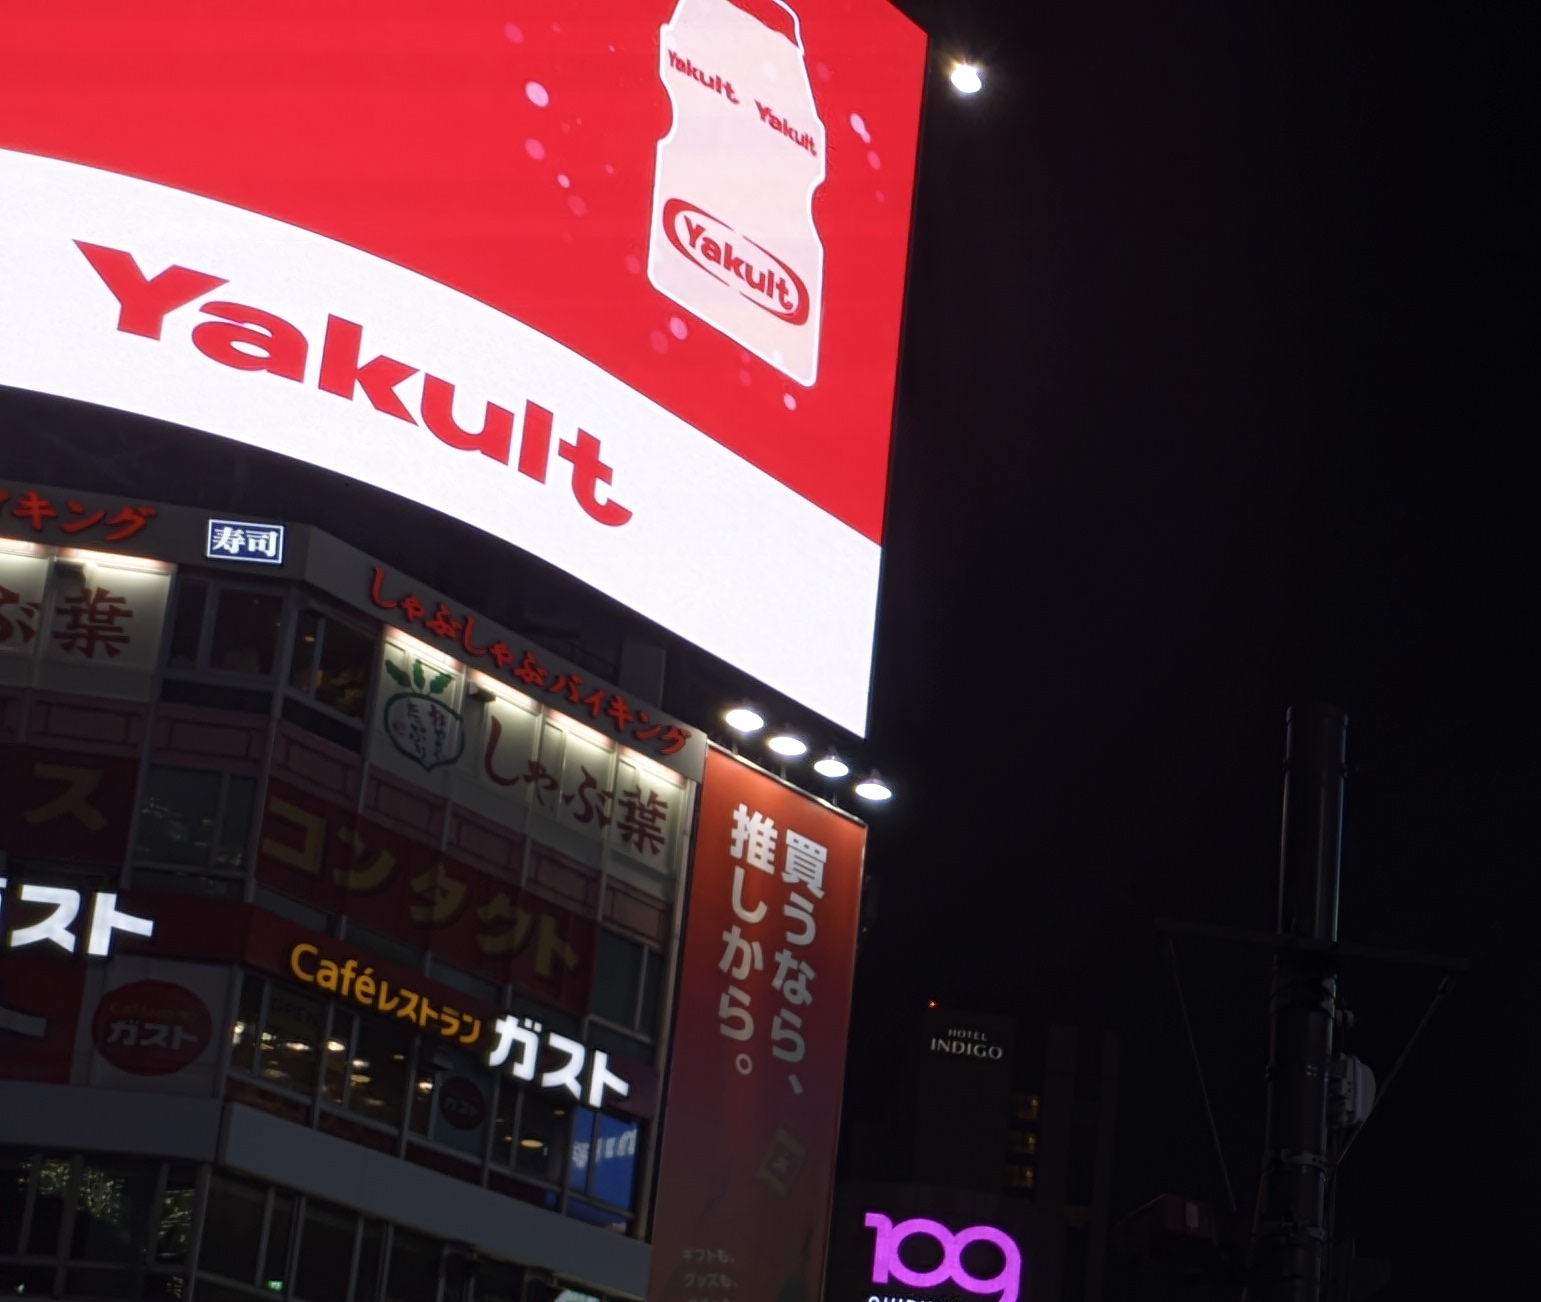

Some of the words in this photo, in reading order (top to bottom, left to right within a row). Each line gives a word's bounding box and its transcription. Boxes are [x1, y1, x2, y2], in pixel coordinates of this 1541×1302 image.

[667, 48, 740, 104] Yakult
[754, 99, 819, 158] Yakult
[681, 213, 796, 312] Yakult
[72, 239, 633, 528] Yakult
[0, 490, 158, 542] キング
[212, 528, 280, 558] 寿司
[370, 567, 692, 756] しゃぶしゃぶバイキング
[484, 716, 668, 855] しゃぶ葉
[0, 876, 155, 957] スト
[262, 797, 581, 978] コンタクト
[718, 803, 779, 1077] 推しから。
[770, 829, 829, 1095] 買うなら、
[105, 1017, 198, 1052] ガスト
[487, 1014, 631, 1109] ガスト
[930, 1038, 1004, 1061] INDIGO
[947, 1028, 988, 1043] HOTEL
